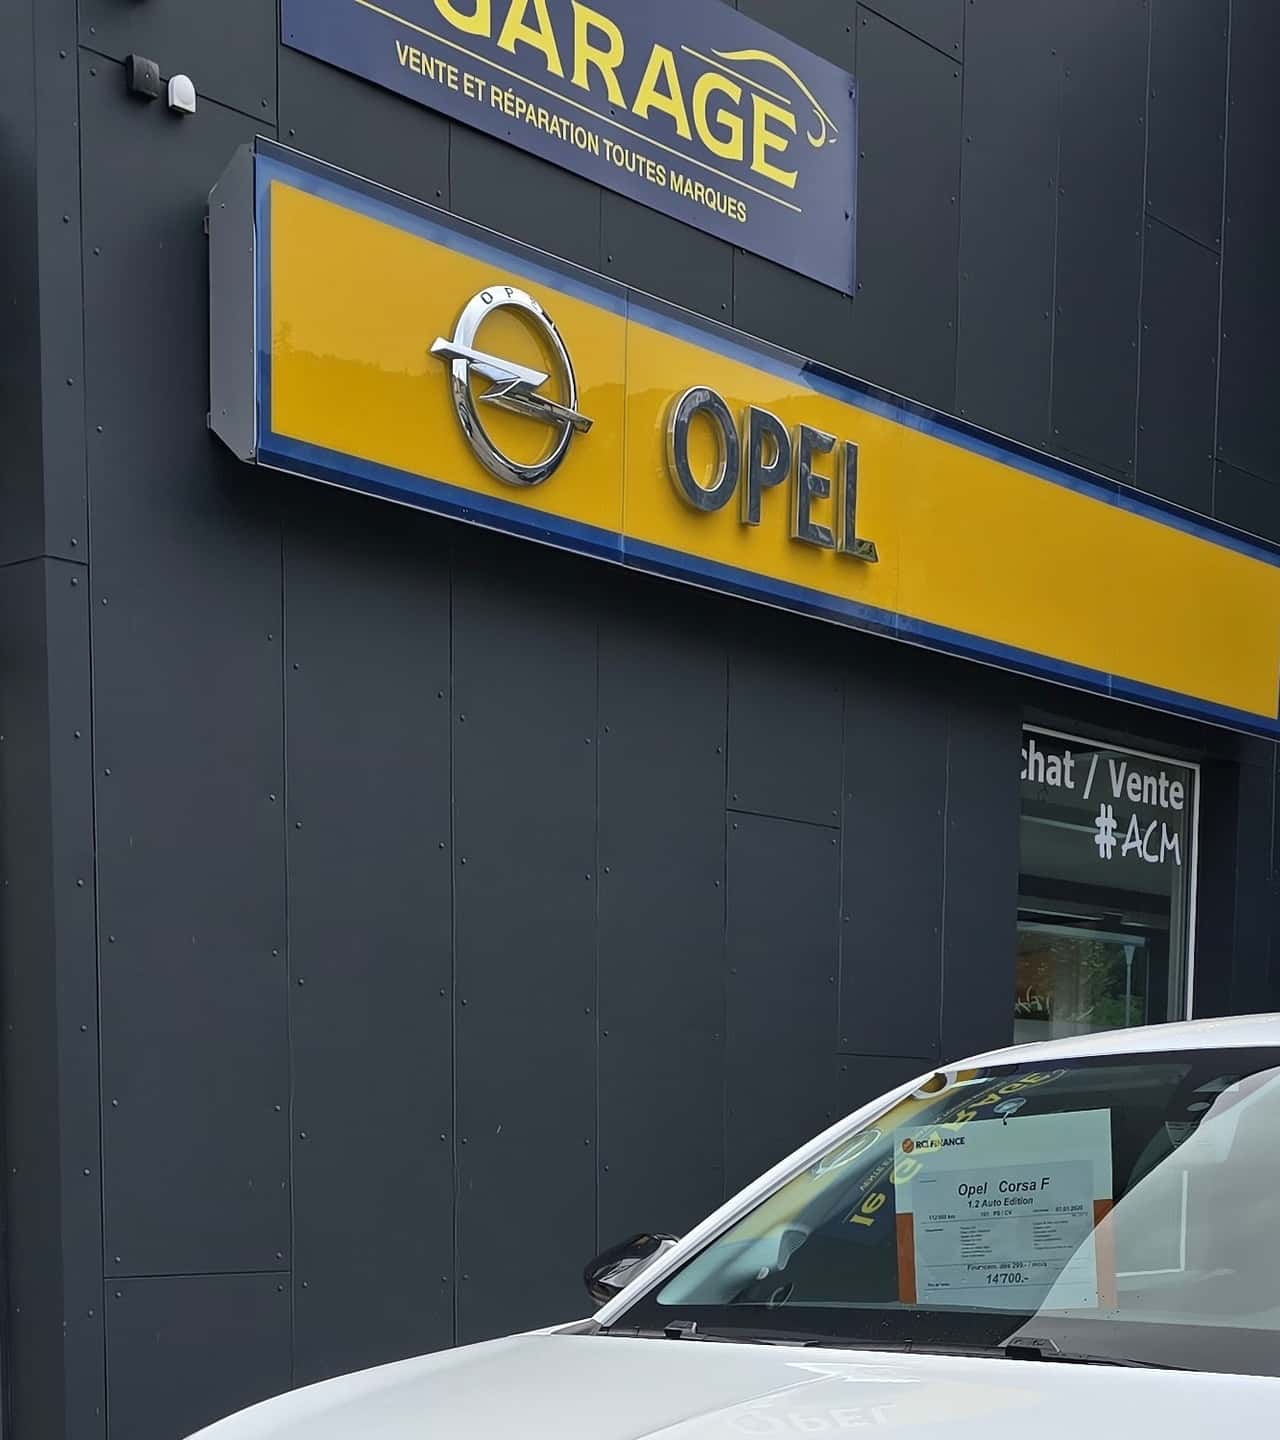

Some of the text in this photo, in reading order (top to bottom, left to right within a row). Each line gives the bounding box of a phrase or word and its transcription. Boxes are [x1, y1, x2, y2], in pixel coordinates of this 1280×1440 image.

[394, 39, 748, 224] VENTE ET RÉPARATION TOUTES MARQUES
[665, 385, 879, 564] OPEL
[1108, 758, 1185, 811] Vente
[958, 1177, 1050, 1198] Opel Corsa F
[967, 1197, 1034, 1209] 1.2 Auto Edition
